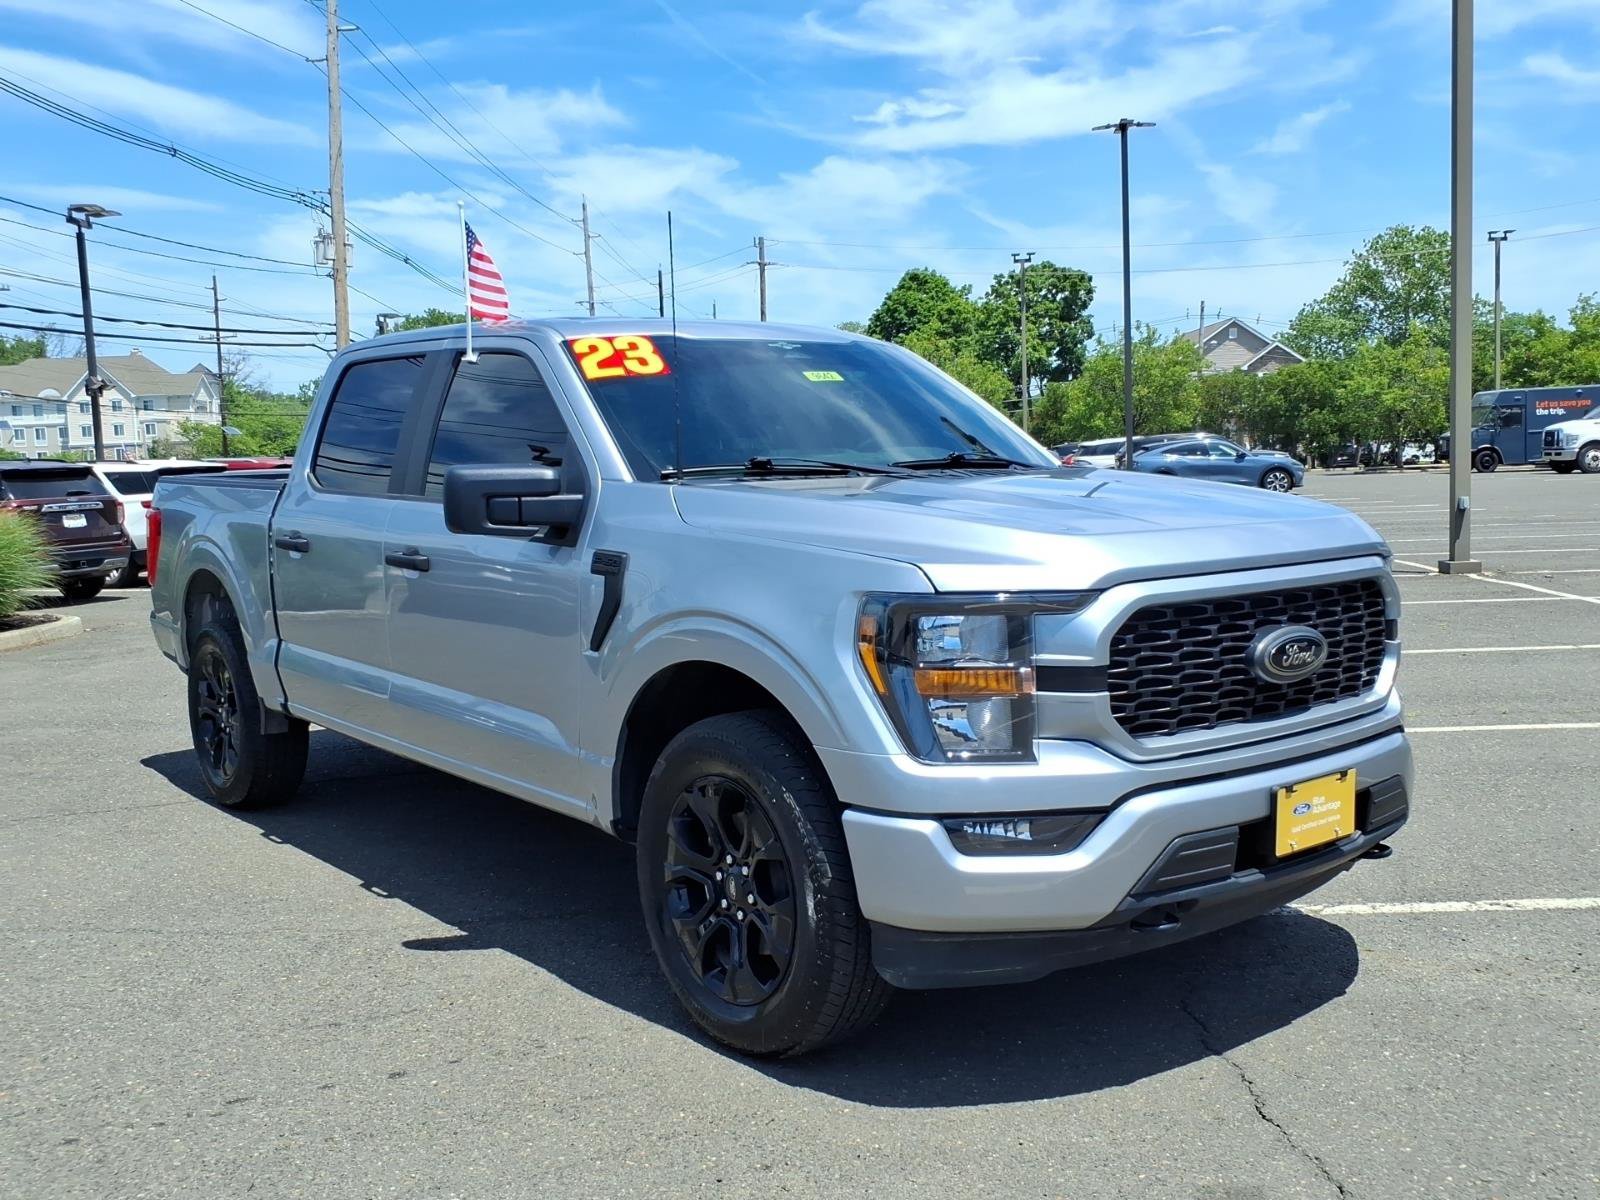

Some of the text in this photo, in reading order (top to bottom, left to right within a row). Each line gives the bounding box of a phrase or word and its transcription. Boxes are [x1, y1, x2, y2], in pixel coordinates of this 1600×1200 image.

[573, 335, 664, 379] 23
[1550, 408, 1566, 416] trip.
[1577, 400, 1591, 408] you
[1282, 642, 1316, 667] Ford
